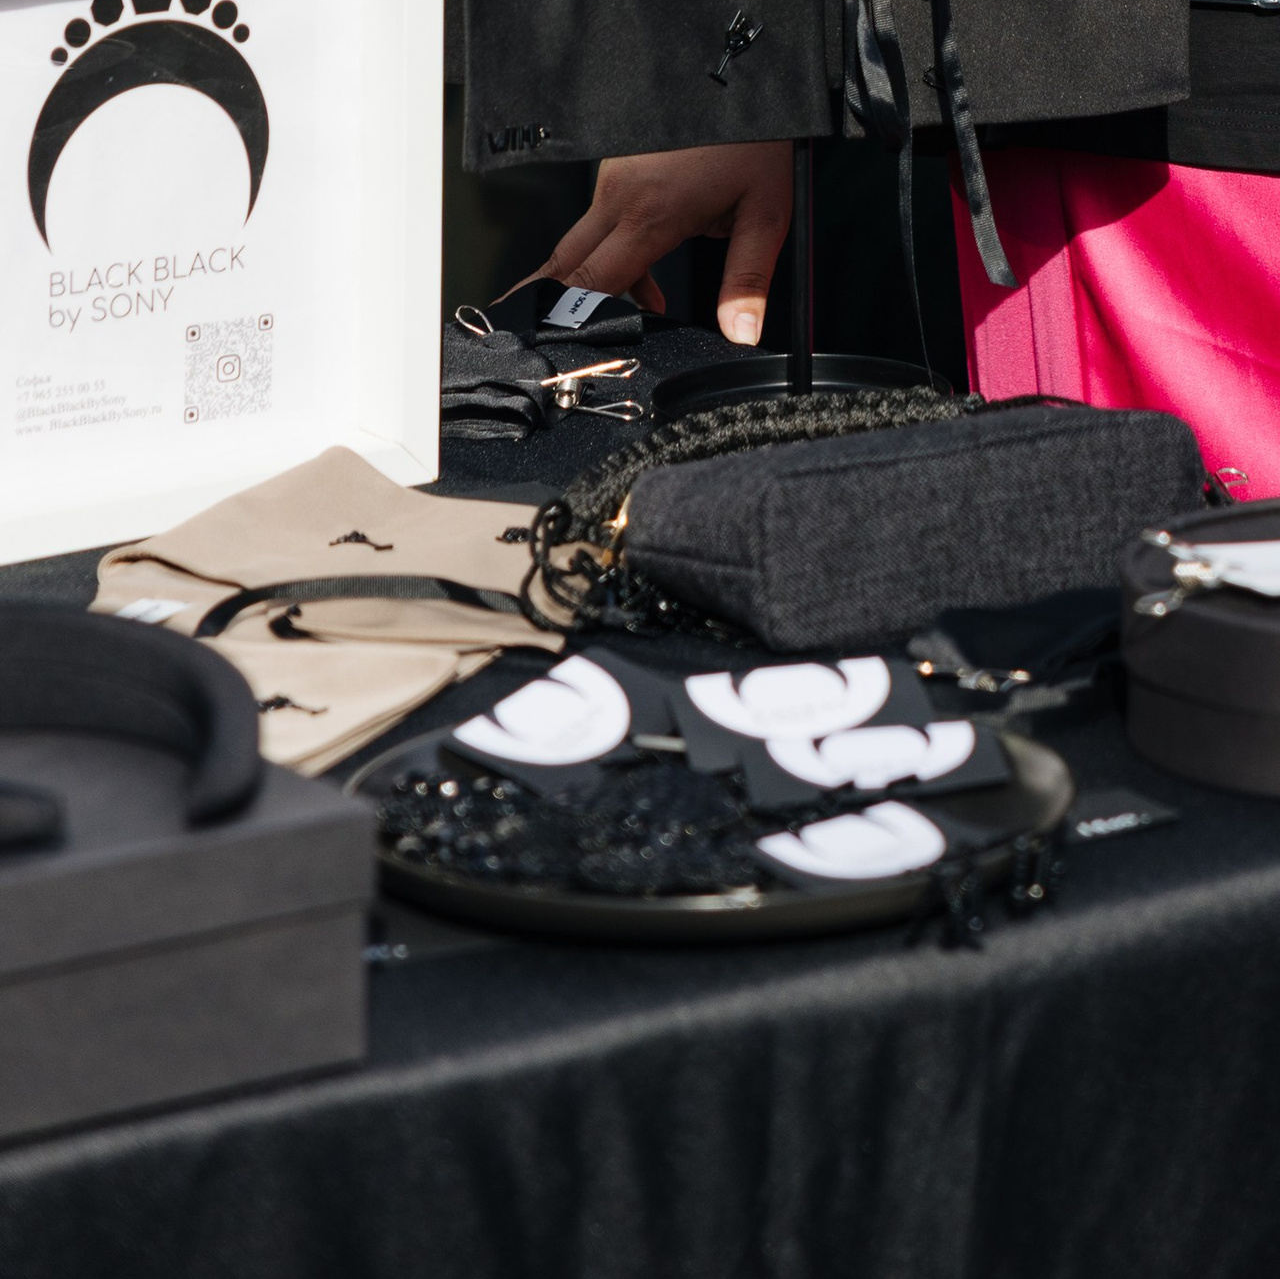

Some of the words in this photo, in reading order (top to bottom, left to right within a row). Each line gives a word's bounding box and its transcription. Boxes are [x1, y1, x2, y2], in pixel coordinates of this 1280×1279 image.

[49, 258, 144, 298] BLACK
[153, 244, 246, 282] BLACK
[48, 302, 82, 334] by
[91, 285, 175, 323] SONY
[568, 296, 587, 315] SONY
